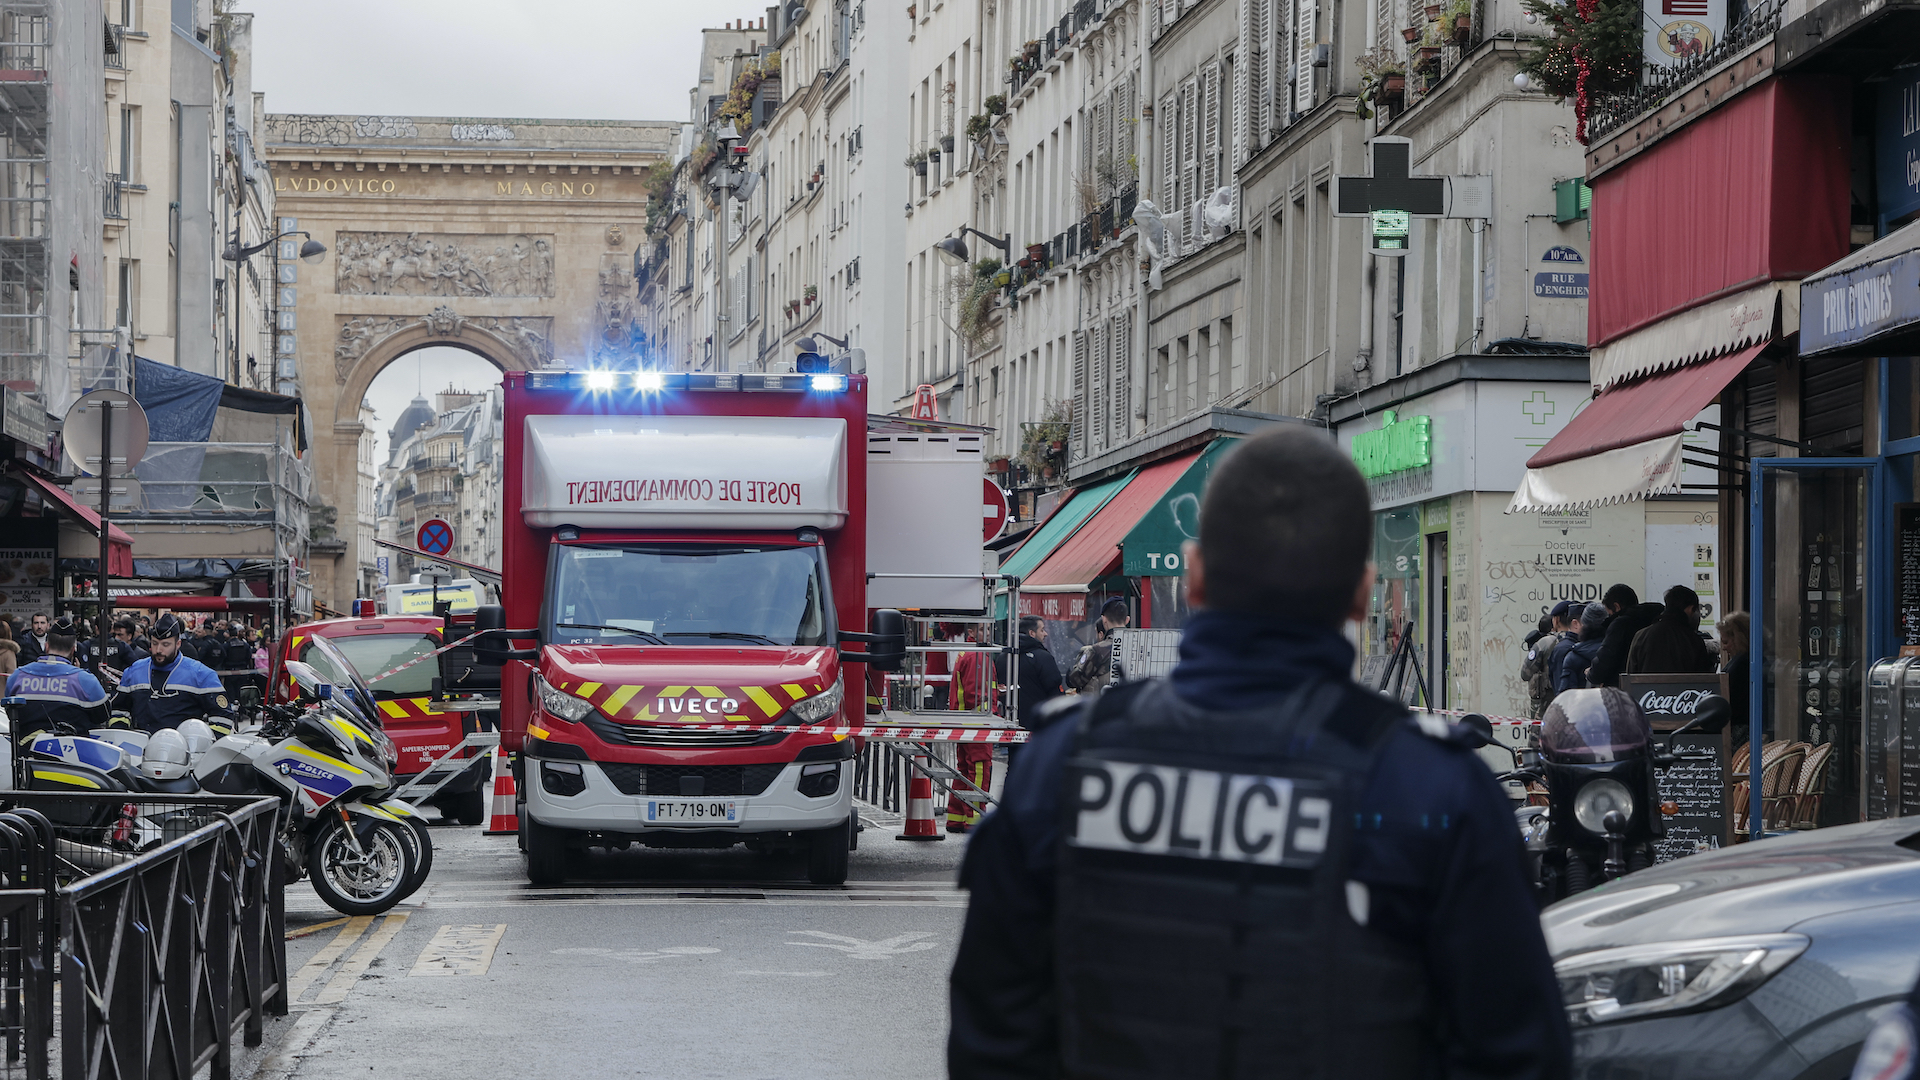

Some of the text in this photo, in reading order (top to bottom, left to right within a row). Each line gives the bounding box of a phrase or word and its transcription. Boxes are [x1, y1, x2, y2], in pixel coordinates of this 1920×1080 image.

[275, 177, 595, 196] LVDOVICO MAGNO
[1552, 274, 1575, 283] RUE
[1535, 283, 1589, 295] D'ENGHIEN
[282, 219, 295, 376] PASSAGE
[1823, 271, 1892, 336] PRIX D'USINES
[919, 391, 931, 418] TA
[1545, 540, 1586, 550] Docteur
[1534, 553, 1596, 566] J. LEVINE
[1528, 583, 1603, 601] du LUNDI
[1520, 613, 1537, 623] au
[1110, 636, 1122, 679] MOYENS
[21, 677, 69, 693] POLICE
[657, 697, 740, 714] IVECO
[1637, 689, 1712, 715] Coca-Col
[1512, 727, 1528, 740] 01
[62, 744, 74, 753] 17
[402, 744, 450, 753] SAPEURS-POMPIERS
[298, 762, 335, 780] POLICE
[658, 803, 726, 817] FT-719-QN
[1072, 764, 1330, 862] POLICE
